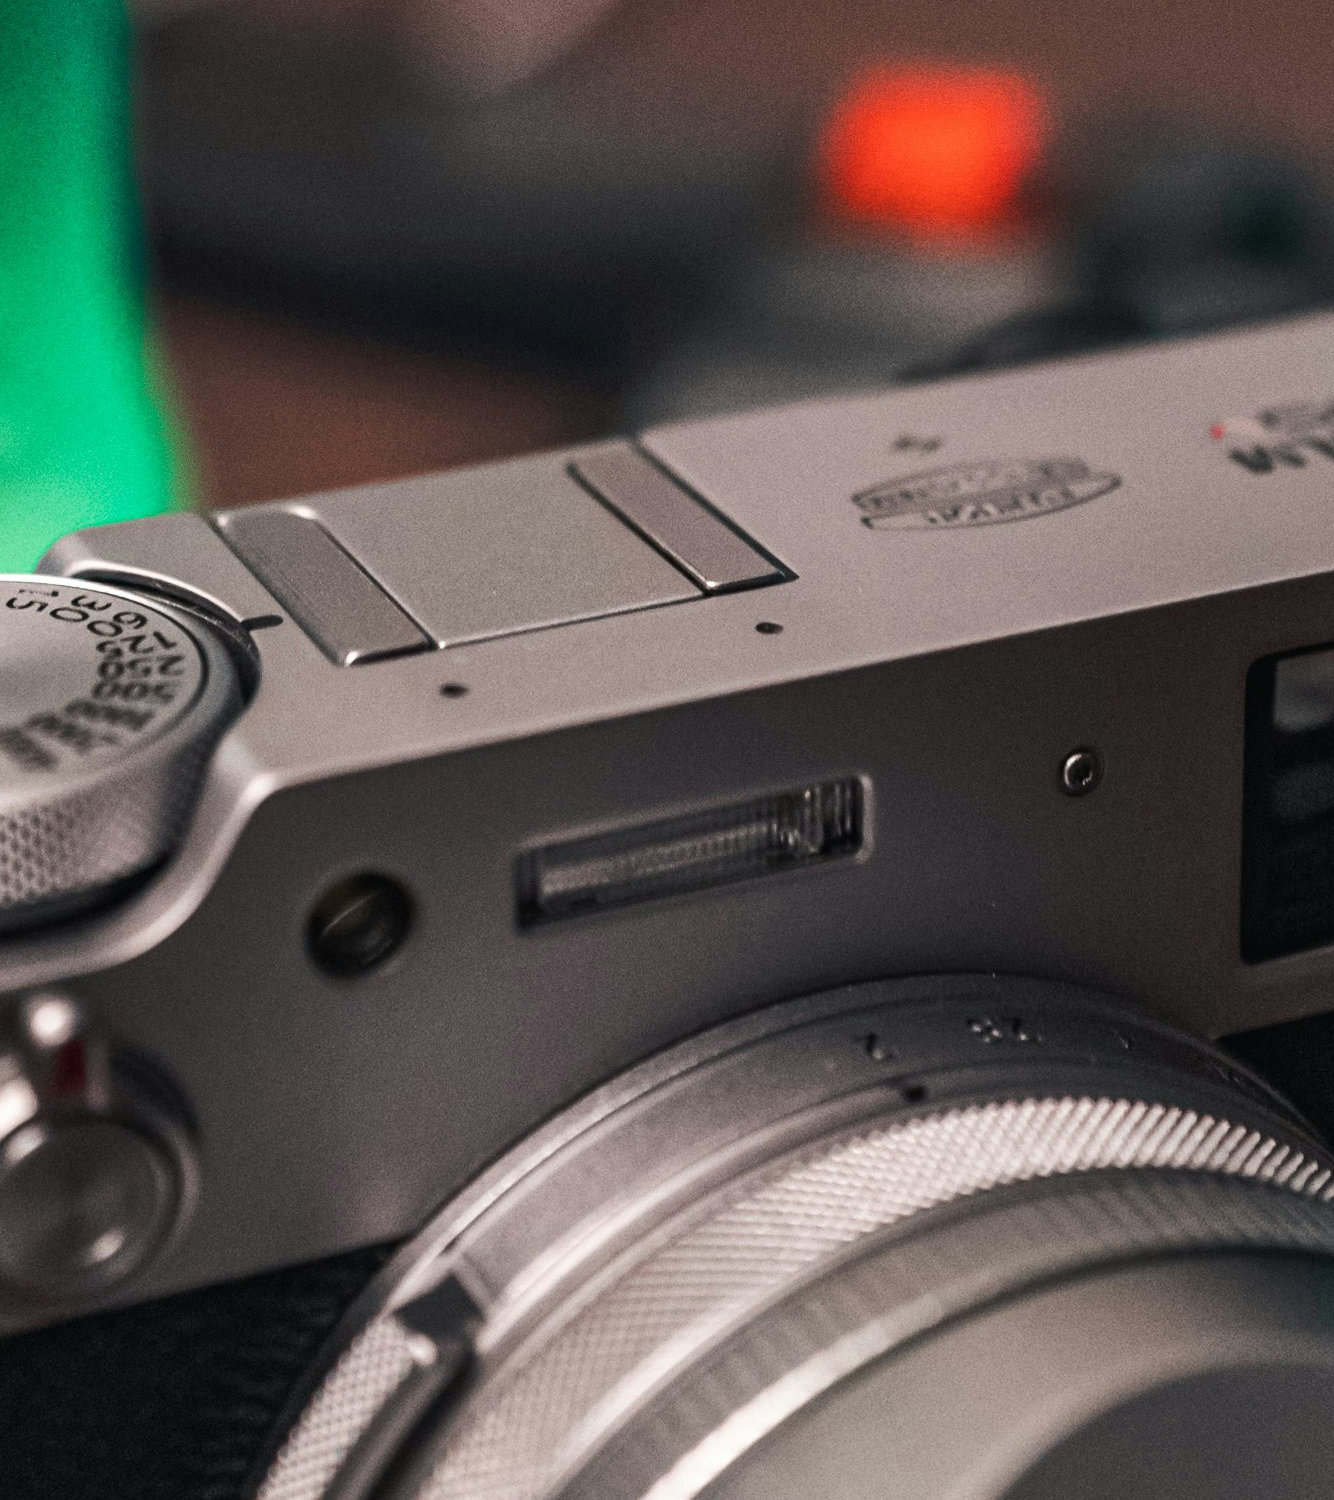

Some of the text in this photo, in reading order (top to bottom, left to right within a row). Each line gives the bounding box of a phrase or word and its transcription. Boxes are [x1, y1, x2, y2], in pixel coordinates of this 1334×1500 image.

[5, 588, 59, 613] 15
[49, 594, 113, 623] 30
[86, 610, 148, 638] 60
[95, 630, 178, 659] 125
[97, 654, 186, 680] 250
